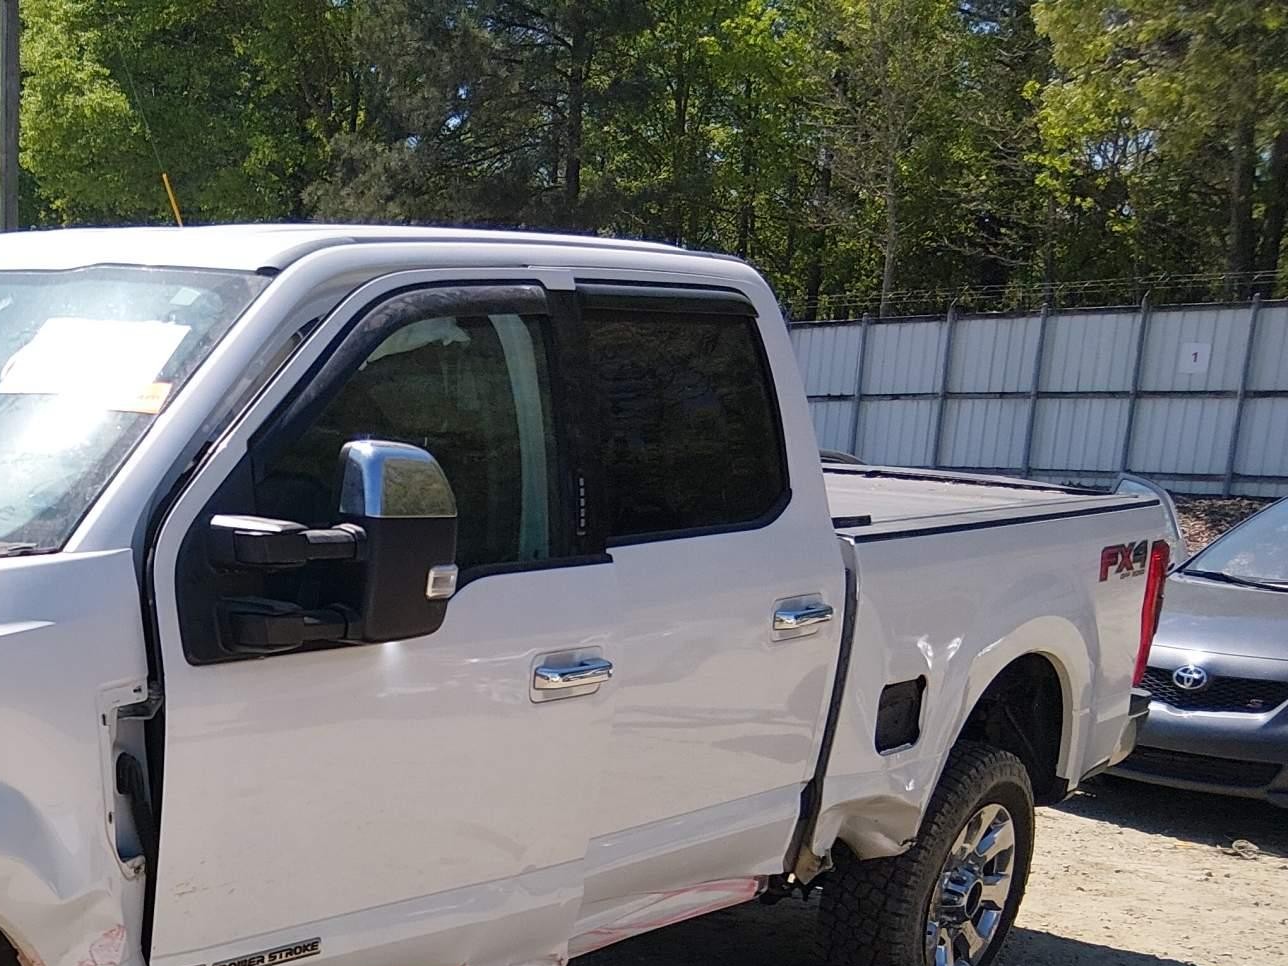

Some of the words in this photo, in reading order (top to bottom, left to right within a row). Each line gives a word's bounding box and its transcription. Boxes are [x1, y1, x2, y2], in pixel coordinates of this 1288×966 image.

[1192, 351, 1199, 363] 1
[1099, 540, 1148, 582] FX4
[267, 941, 320, 962] STROKE
